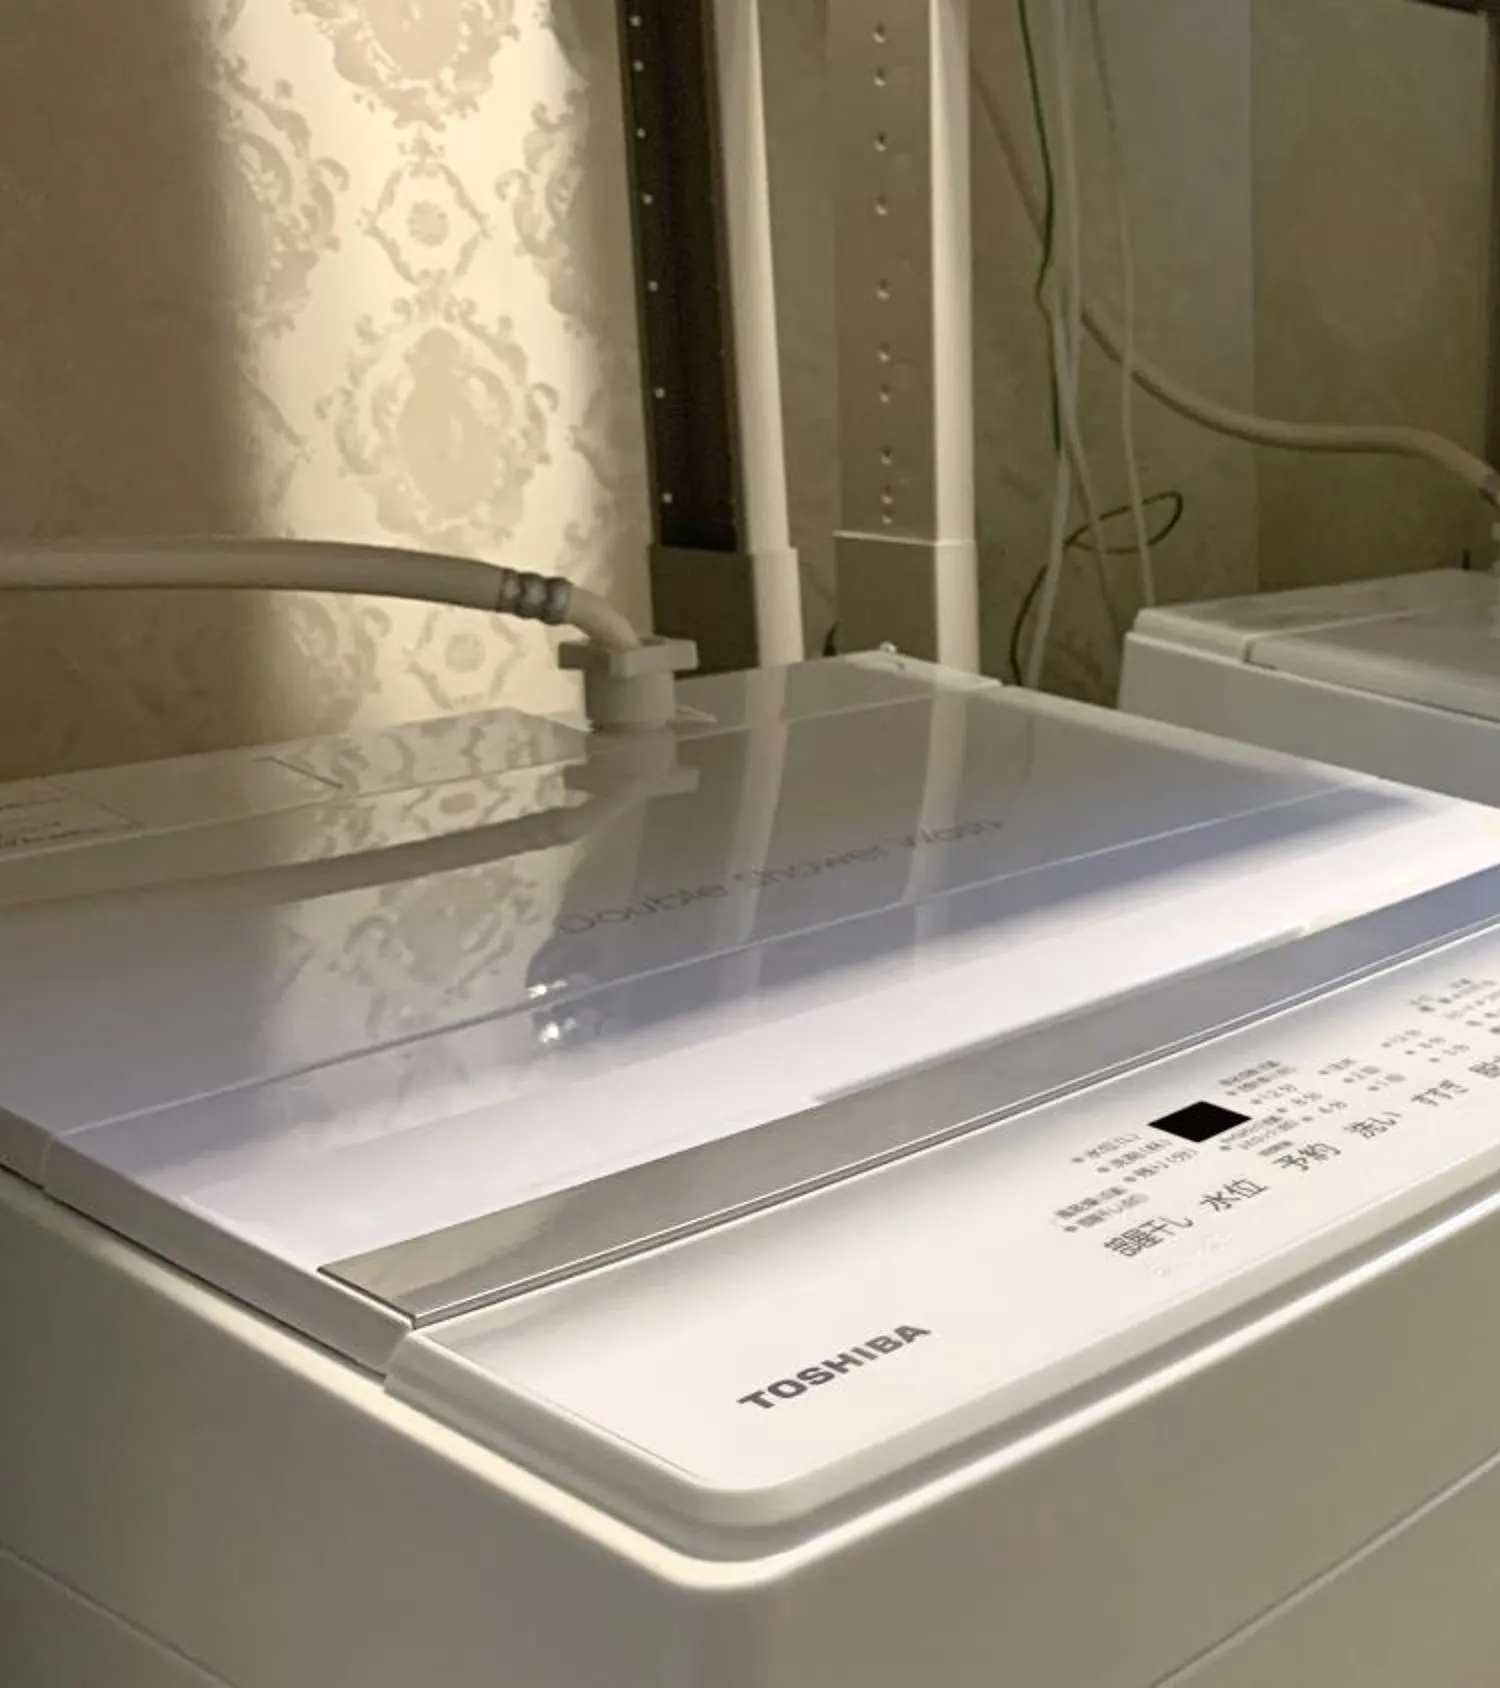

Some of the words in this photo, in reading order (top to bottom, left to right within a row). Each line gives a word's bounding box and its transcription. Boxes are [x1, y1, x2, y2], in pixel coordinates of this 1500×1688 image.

[1411, 1079, 1469, 1107] すすぎ
[1342, 1111, 1403, 1139] 洗い
[1272, 1142, 1342, 1172] 予約
[1199, 1177, 1270, 1212] 水位
[1103, 1216, 1193, 1256] 部屋干し
[736, 1325, 932, 1409] TOSHIBA
